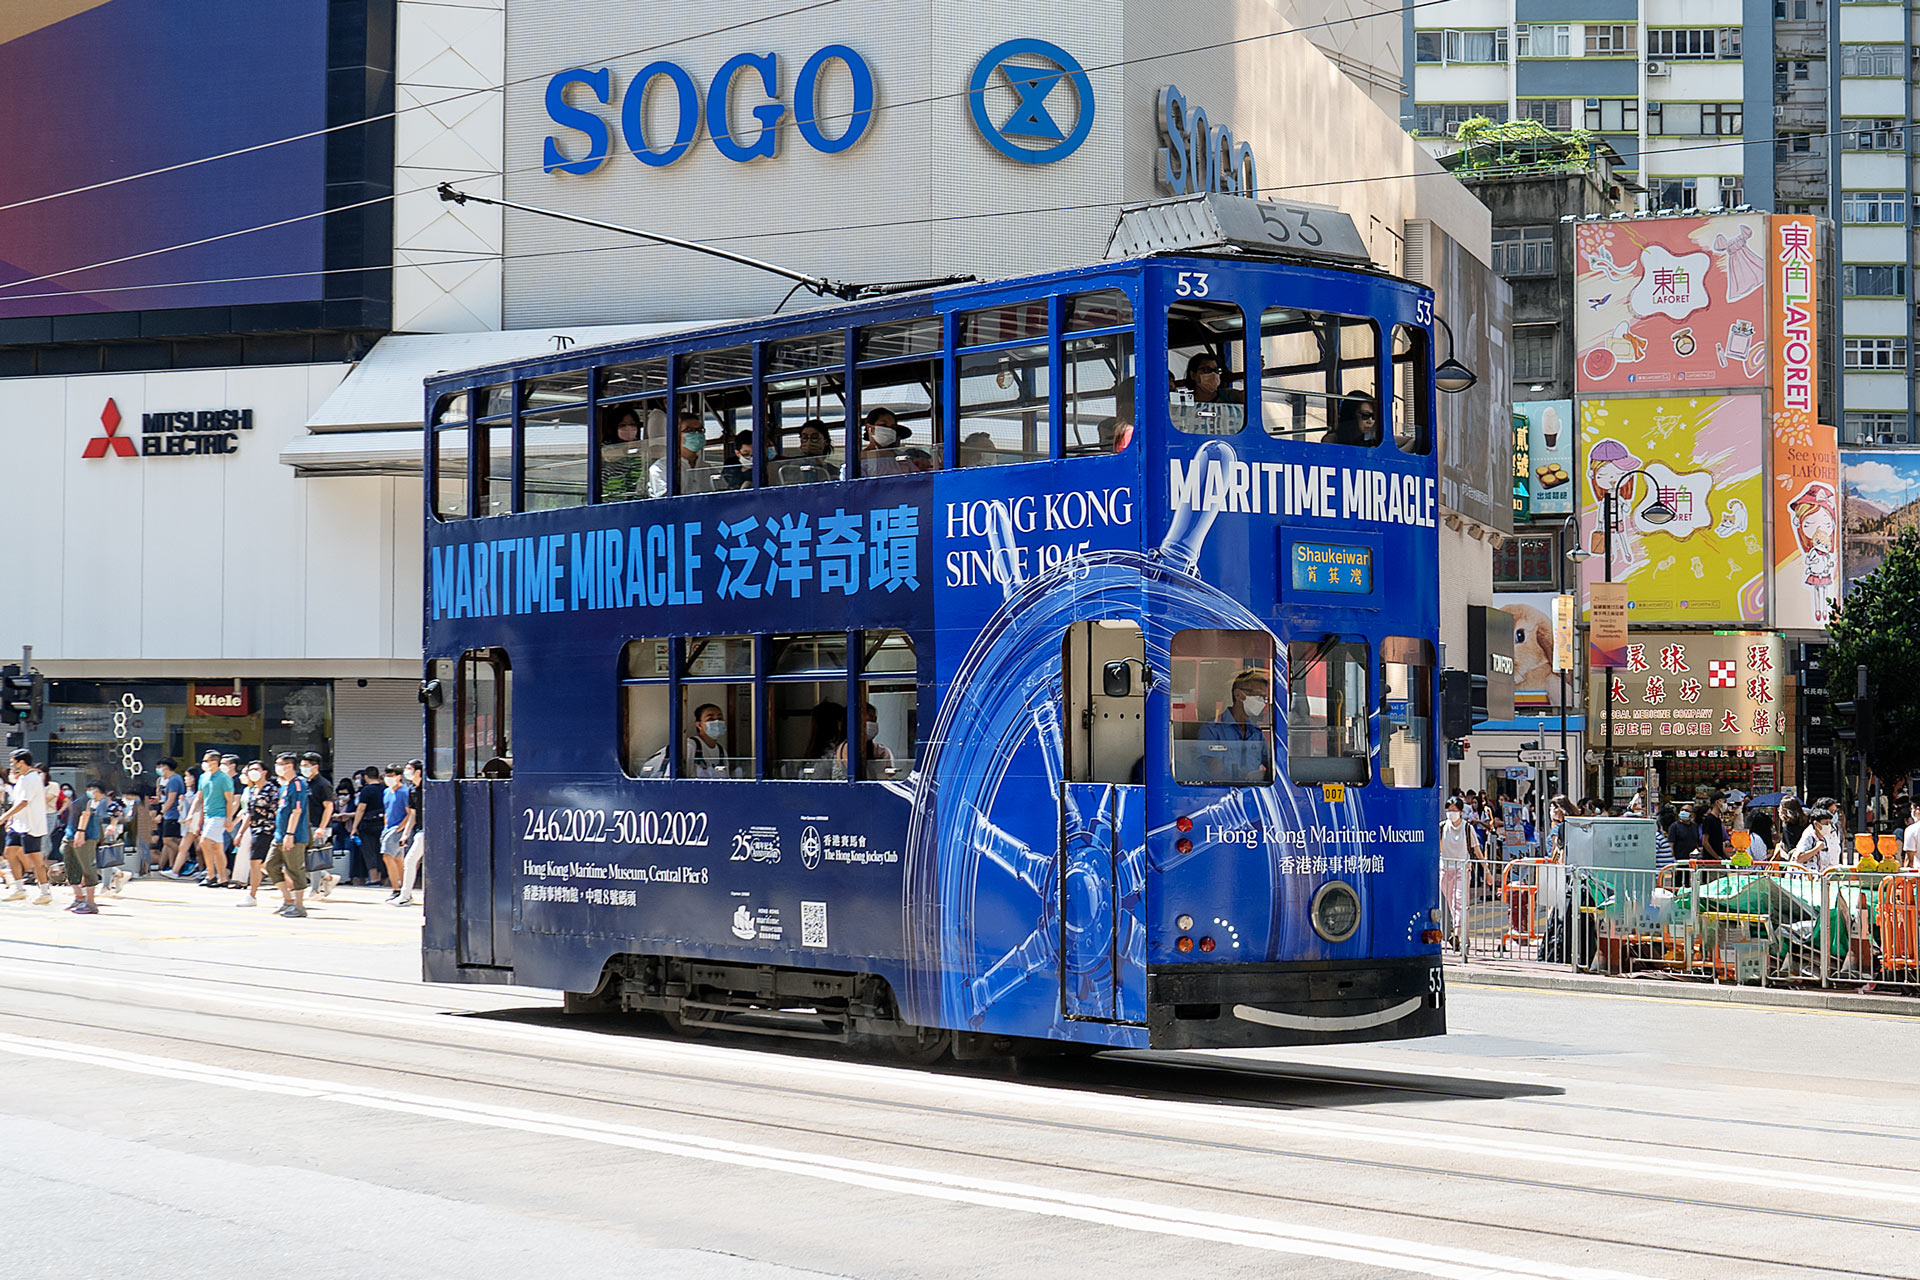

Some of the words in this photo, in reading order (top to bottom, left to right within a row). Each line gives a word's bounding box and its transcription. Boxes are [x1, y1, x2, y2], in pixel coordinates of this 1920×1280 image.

[542, 44, 876, 176] SOGO
[1158, 85, 1258, 200] SOGO
[1256, 204, 1322, 247] 53
[1175, 272, 1209, 297] 53
[1416, 299, 1431, 325] 53
[1652, 295, 1690, 305] LAFORET
[1786, 295, 1809, 410] LAFORET
[142, 408, 254, 434] MITSUBISHI
[142, 432, 239, 456] ELECTRIC
[1787, 448, 1809, 461] See
[1812, 452, 1830, 466] you
[1169, 458, 1337, 519] MARITIME
[1341, 468, 1436, 528] MIRACLE
[946, 495, 1038, 539] HONG
[1044, 486, 1134, 531] KONG
[432, 532, 566, 621] MARITIME
[571, 521, 703, 613] MIRACLE
[713, 503, 921, 601] 泛洋奇蹟
[946, 546, 1031, 588] SINCE
[1036, 539, 1091, 581] 1945
[195, 694, 242, 707] Miele
[1600, 708, 1632, 720] GOBAL
[1632, 709, 1672, 720] MEDICINE
[1673, 708, 1714, 719] COMPANY
[1325, 788, 1343, 799] 007
[730, 834, 752, 861] 25
[823, 834, 867, 848] 香港賽馬會
[1205, 824, 1258, 848] Hong
[1262, 824, 1307, 848] Kong
[1310, 824, 1377, 844] Maritime
[1379, 825, 1425, 843] Museum
[823, 849, 835, 860] The
[835, 849, 851, 864] Hong
[851, 850, 866, 864] Kong
[864, 850, 883, 865] Jockey
[884, 850, 898, 863] Club
[1279, 855, 1385, 875] 香港海事博物館
[523, 859, 547, 880] Hong
[547, 860, 569, 881] Kong
[569, 861, 608, 880] Maritime
[608, 863, 649, 884] Museum,
[649, 865, 682, 883] Central
[683, 866, 701, 884] Pier
[701, 868, 709, 885] 8
[1429, 967, 1442, 992] 53
